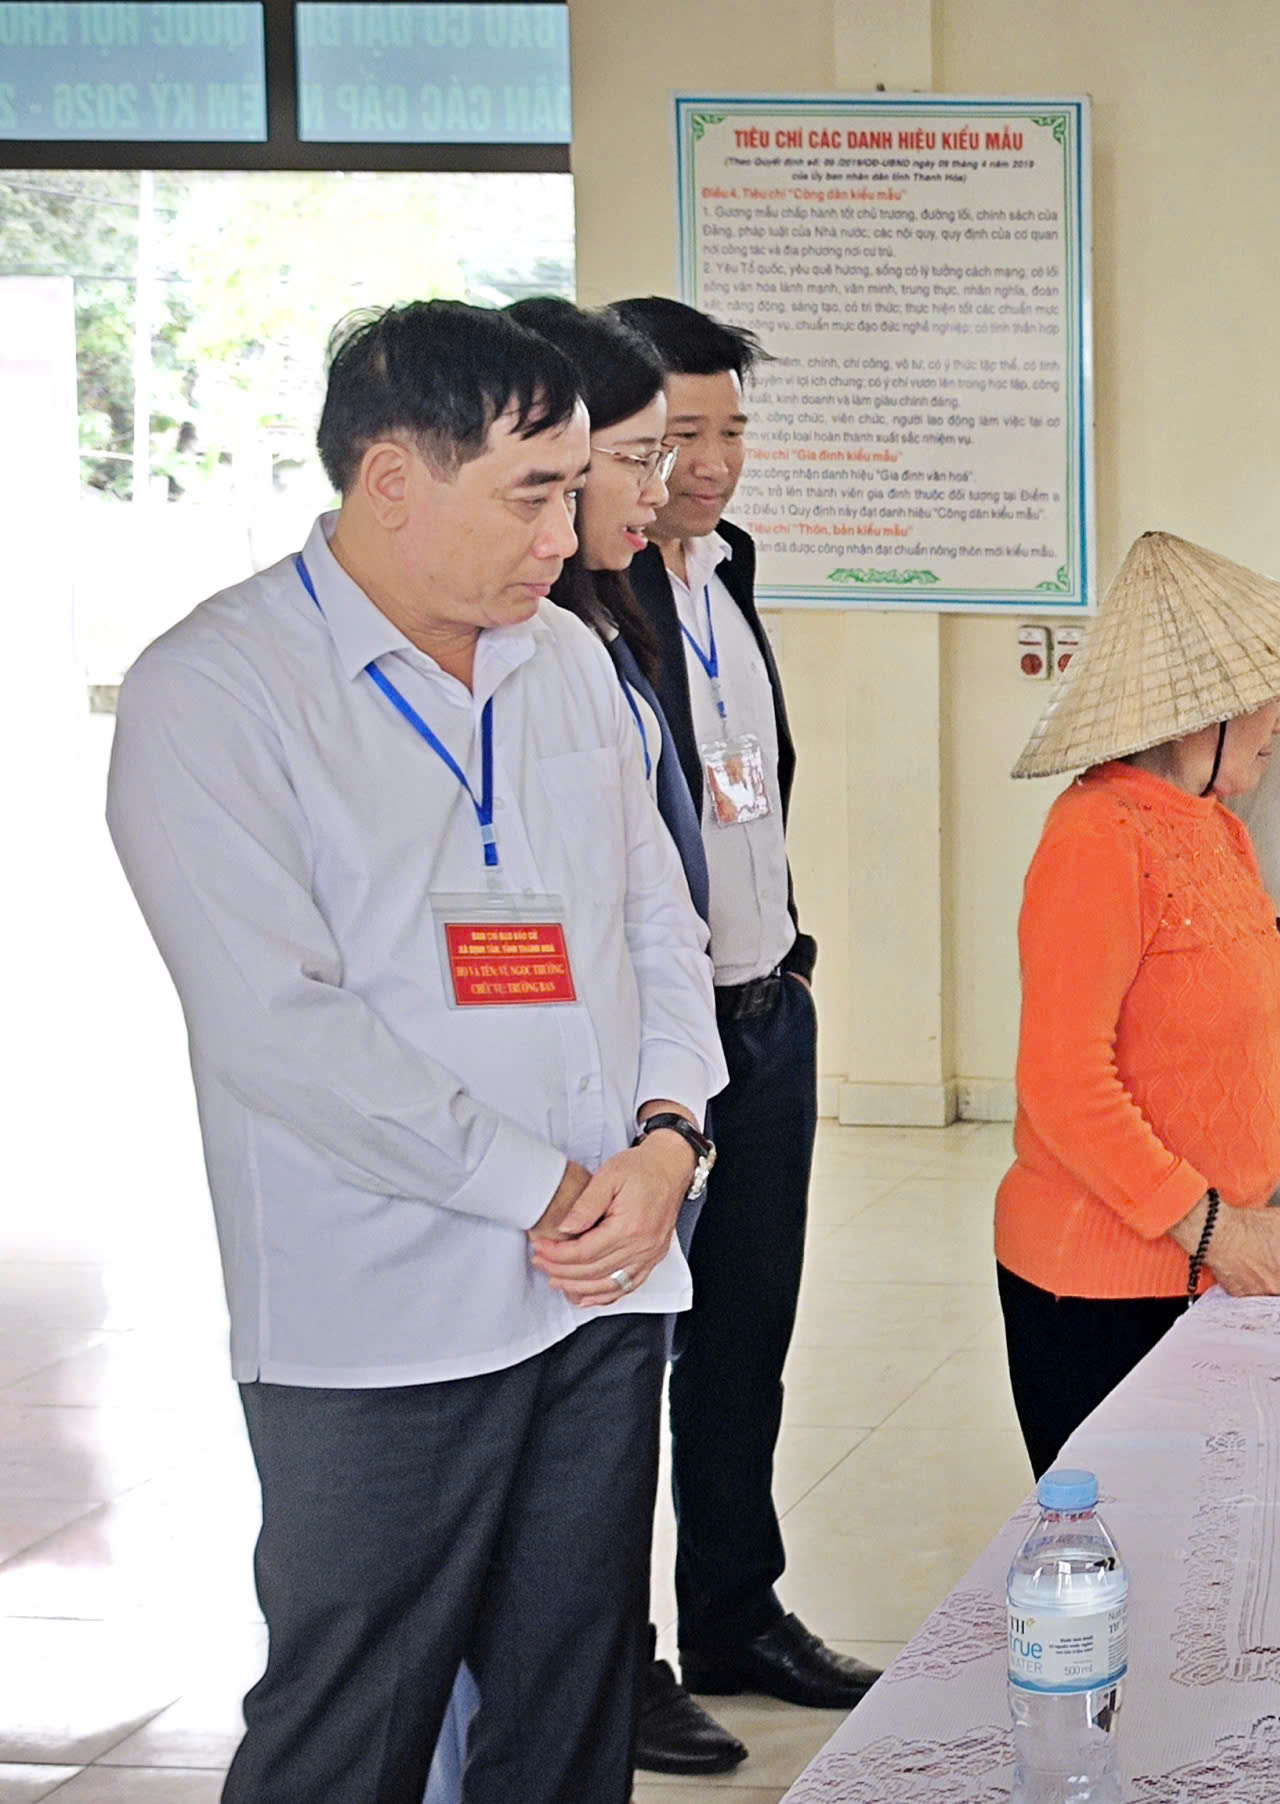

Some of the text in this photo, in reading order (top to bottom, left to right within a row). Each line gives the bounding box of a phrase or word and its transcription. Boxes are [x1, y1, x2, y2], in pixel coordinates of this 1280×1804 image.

[734, 124, 1024, 153] TIÊU CHÍ CÁC DANH HIỆU KIỂU MẪU
[811, 207, 839, 219] hành
[921, 206, 956, 223] đường
[976, 208, 1007, 220] chính
[1008, 209, 1036, 221] sách
[1037, 209, 1058, 221] của
[739, 225, 767, 240] pháp
[791, 225, 812, 237] của
[815, 226, 837, 238] Nhà
[873, 226, 893, 238] các
[941, 230, 962, 243] quy
[964, 228, 989, 242] định
[991, 228, 1011, 240] của
[1031, 231, 1058, 244] quan
[721, 244, 748, 259] công
[801, 245, 843, 260] phương
[965, 265, 993, 277] cách
[813, 430, 842, 442] hoàn
[792, 468, 821, 482] nhận
[821, 469, 849, 480] danh
[926, 470, 948, 482] văn
[787, 504, 812, 519] Quy
[812, 505, 838, 519] định
[879, 506, 906, 517] danh
[816, 542, 845, 557] công
[845, 542, 873, 557] nhận
[929, 544, 957, 559] nông
